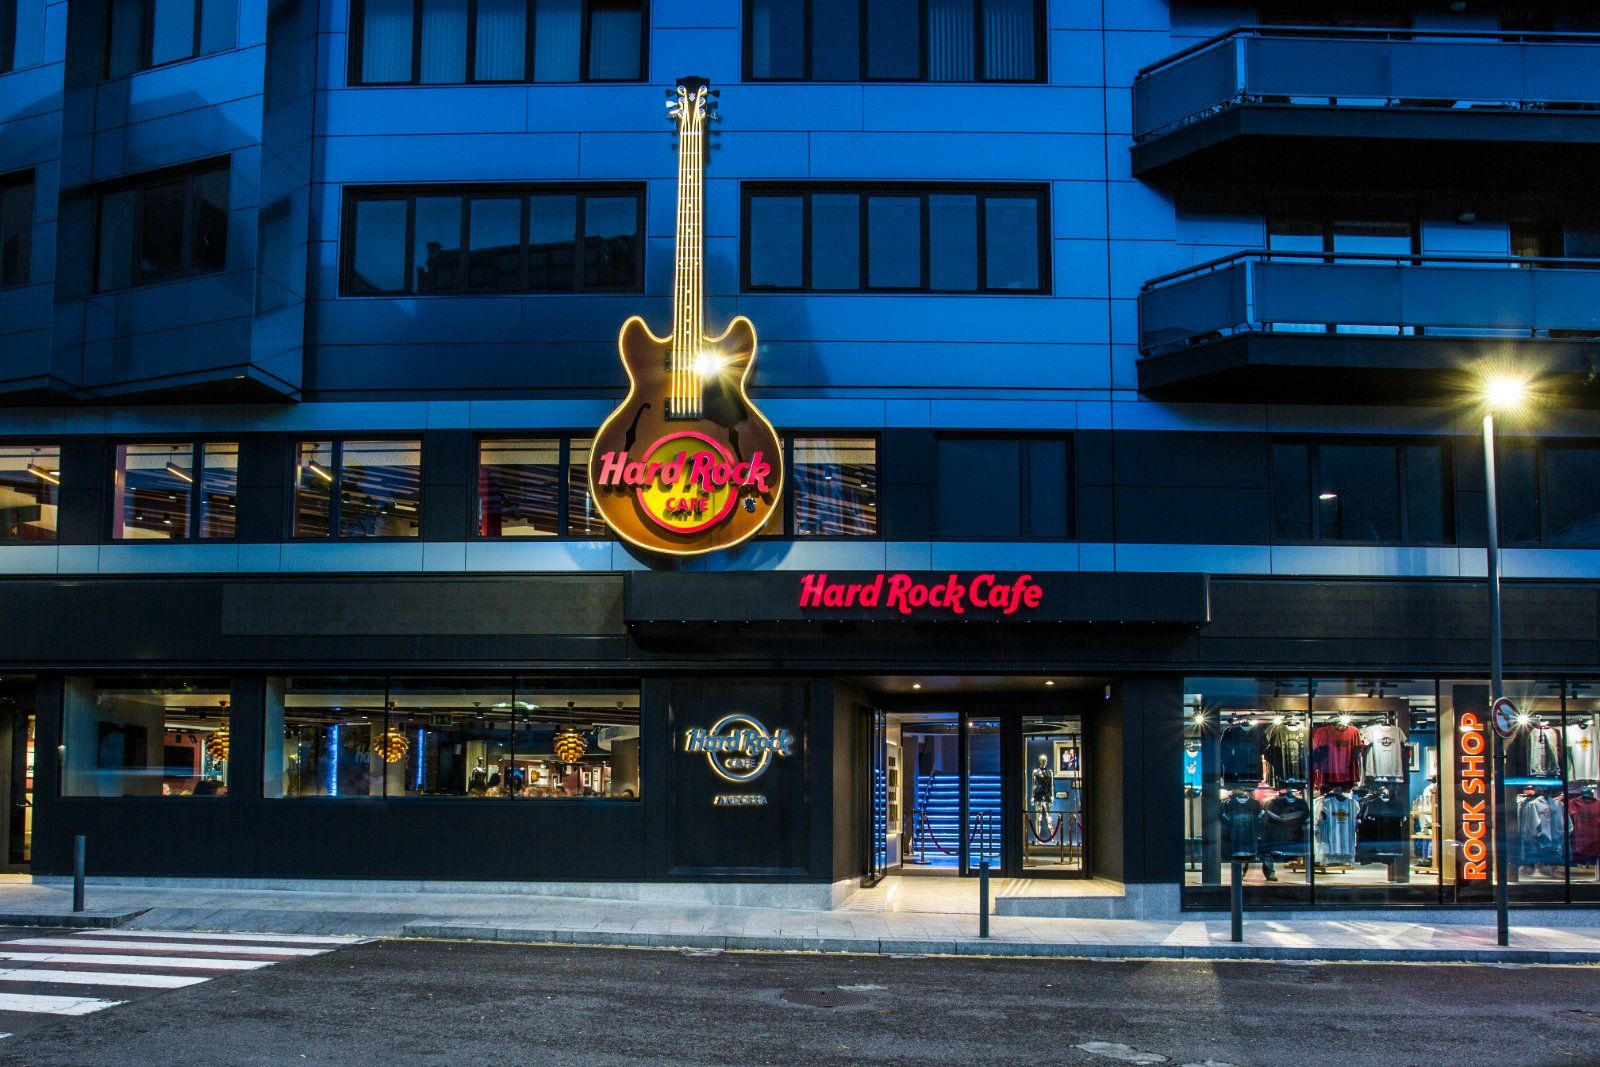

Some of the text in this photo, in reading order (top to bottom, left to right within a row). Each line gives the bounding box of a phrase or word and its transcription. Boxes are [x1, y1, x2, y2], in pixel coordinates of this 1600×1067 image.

[598, 451, 771, 492] Hard Rock
[665, 497, 709, 511] CAFE
[800, 573, 1043, 615] Hard Rock Cafe
[685, 729, 793, 756] Hard Rock
[725, 758, 756, 769] CAFE
[1461, 712, 1487, 880] ROCK SHOP
